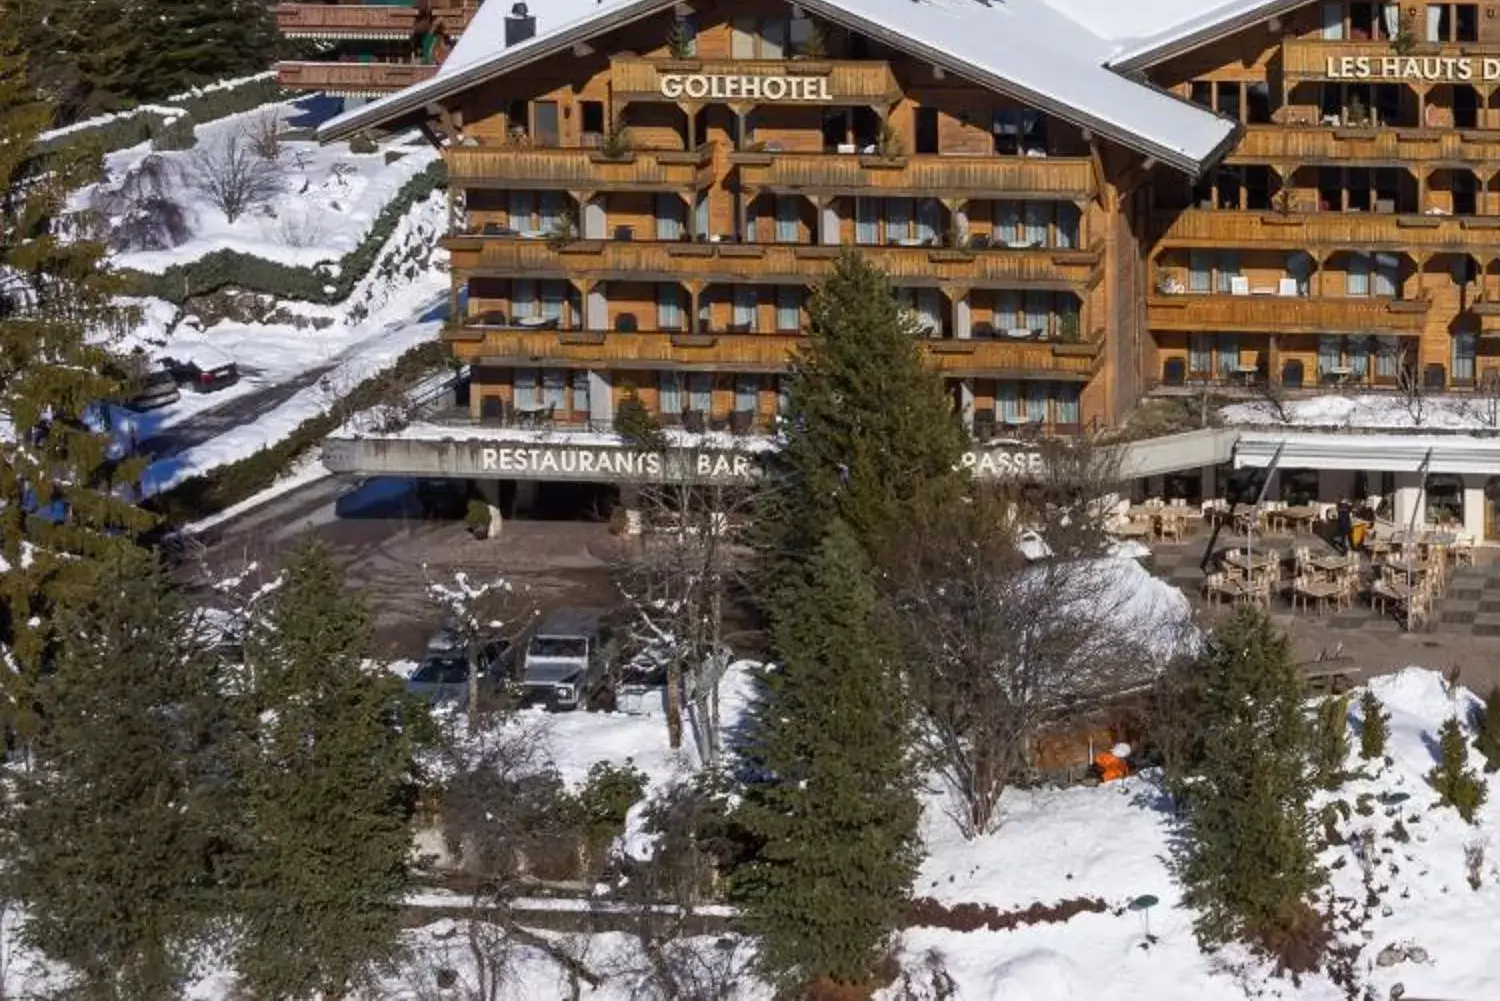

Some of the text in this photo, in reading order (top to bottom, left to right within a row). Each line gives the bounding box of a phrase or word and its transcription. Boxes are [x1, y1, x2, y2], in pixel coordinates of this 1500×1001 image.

[1326, 55, 1371, 78] LES
[1381, 56, 1473, 80] HAUTS
[660, 74, 833, 100] GOLFHOTEL
[482, 447, 662, 475] RESTAURANTS
[697, 453, 749, 477] BAR
